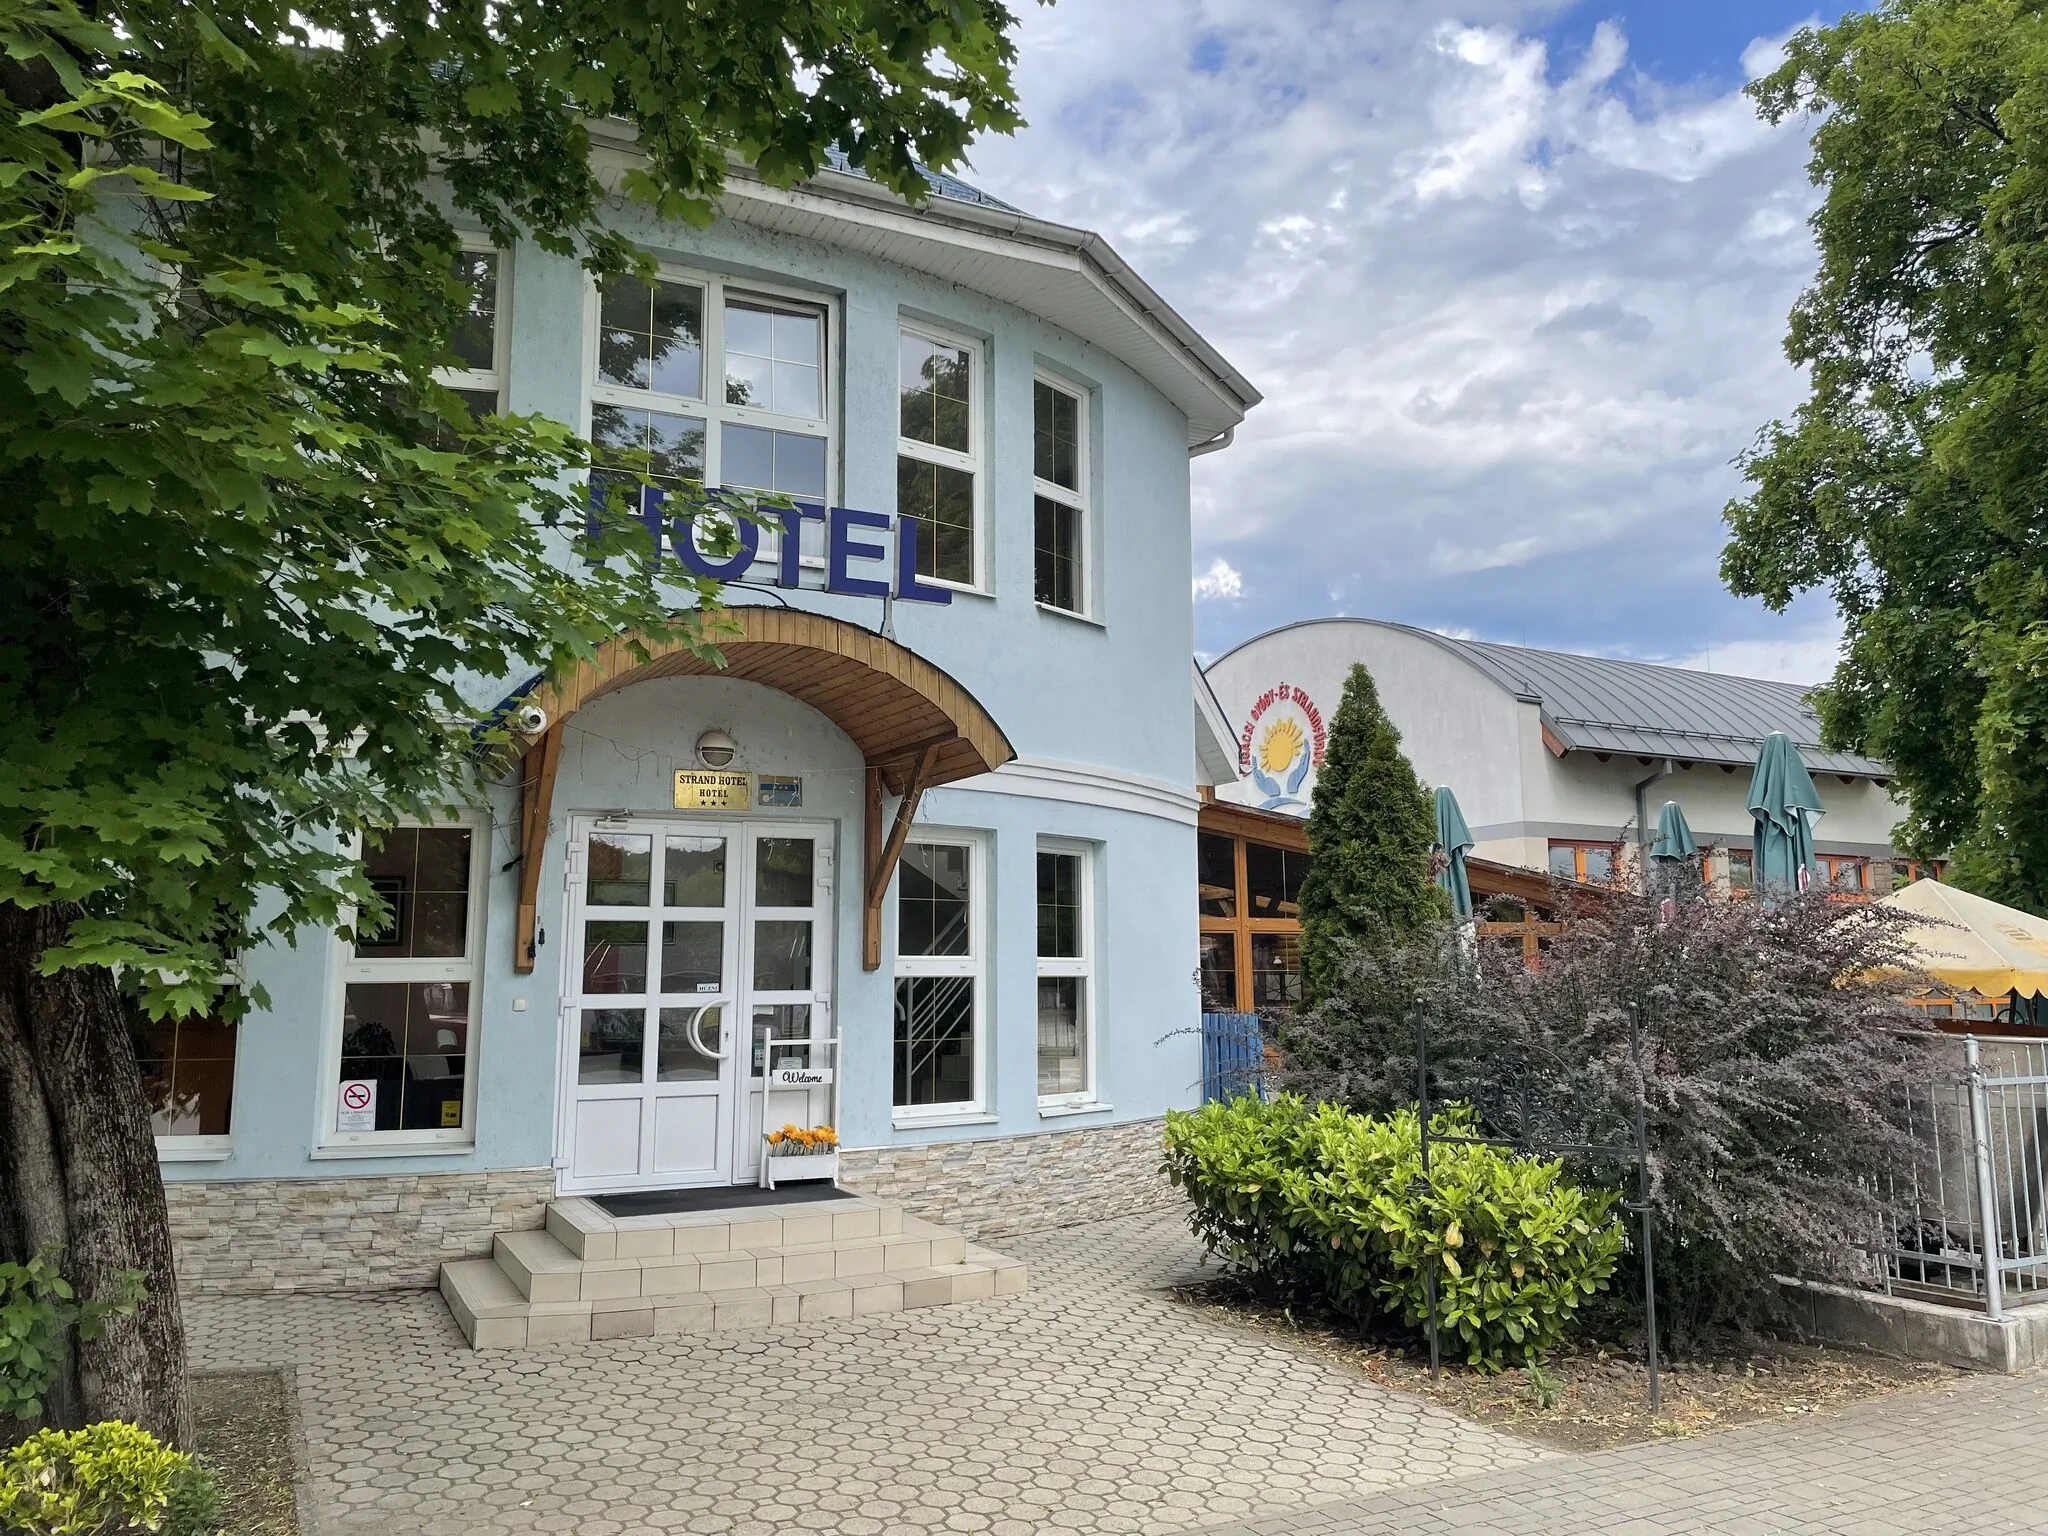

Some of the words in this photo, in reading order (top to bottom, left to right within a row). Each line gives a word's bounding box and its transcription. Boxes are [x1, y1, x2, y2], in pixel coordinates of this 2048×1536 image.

[583, 473, 953, 606] HOTEL
[680, 774, 716, 785] STRAND
[718, 776, 748, 786] HOTEL
[699, 788, 728, 798] HOTEL
[782, 1071, 823, 1084] Welcome
